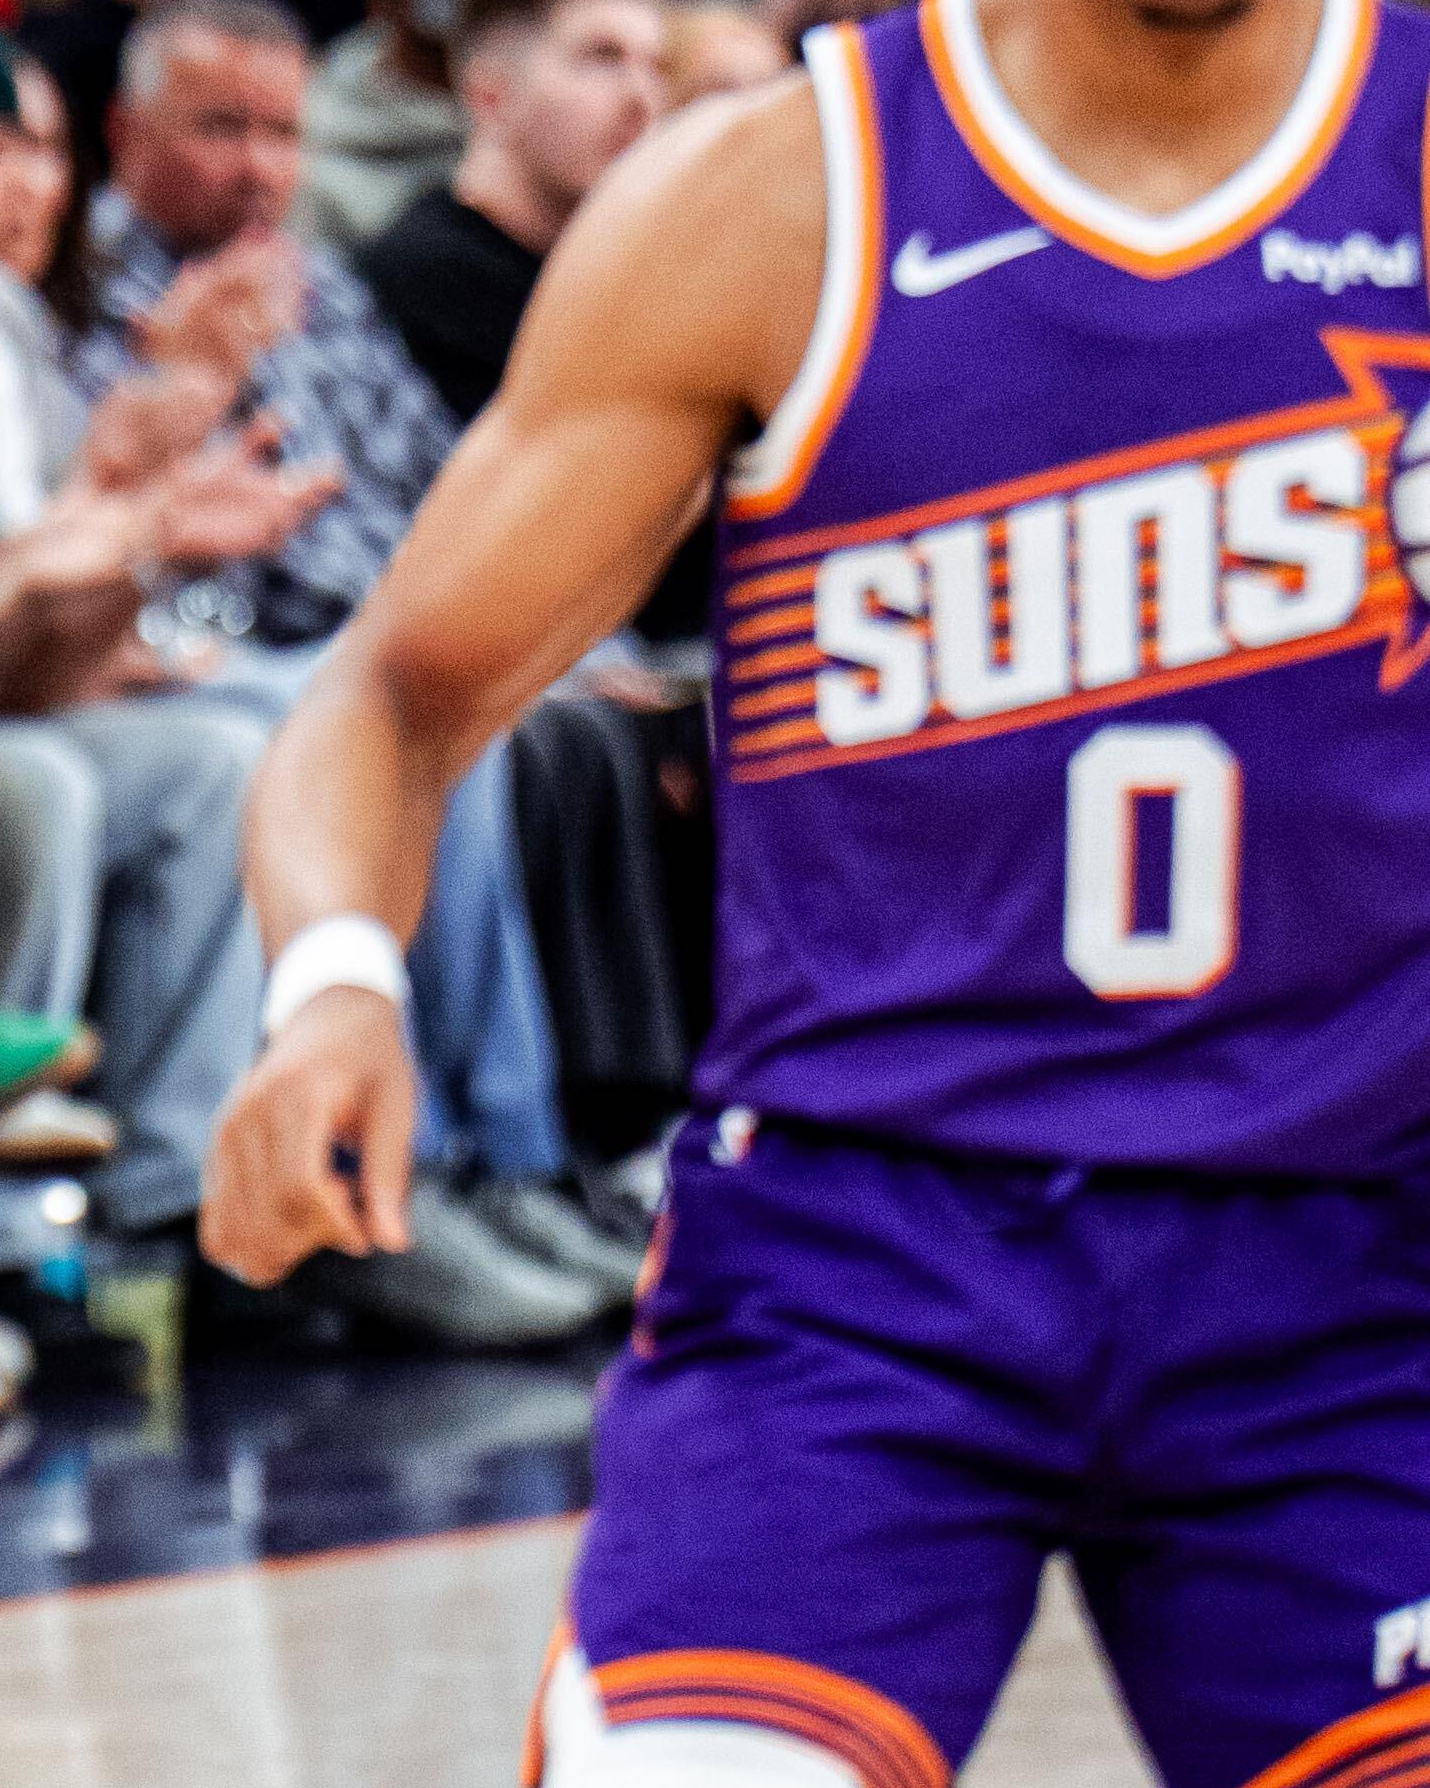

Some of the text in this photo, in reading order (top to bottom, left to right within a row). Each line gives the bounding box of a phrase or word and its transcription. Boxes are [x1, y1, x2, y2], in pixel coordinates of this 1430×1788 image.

[1261, 229, 1422, 295] PayPal
[814, 426, 1367, 747] SUNS
[1063, 723, 1242, 1000] 0
